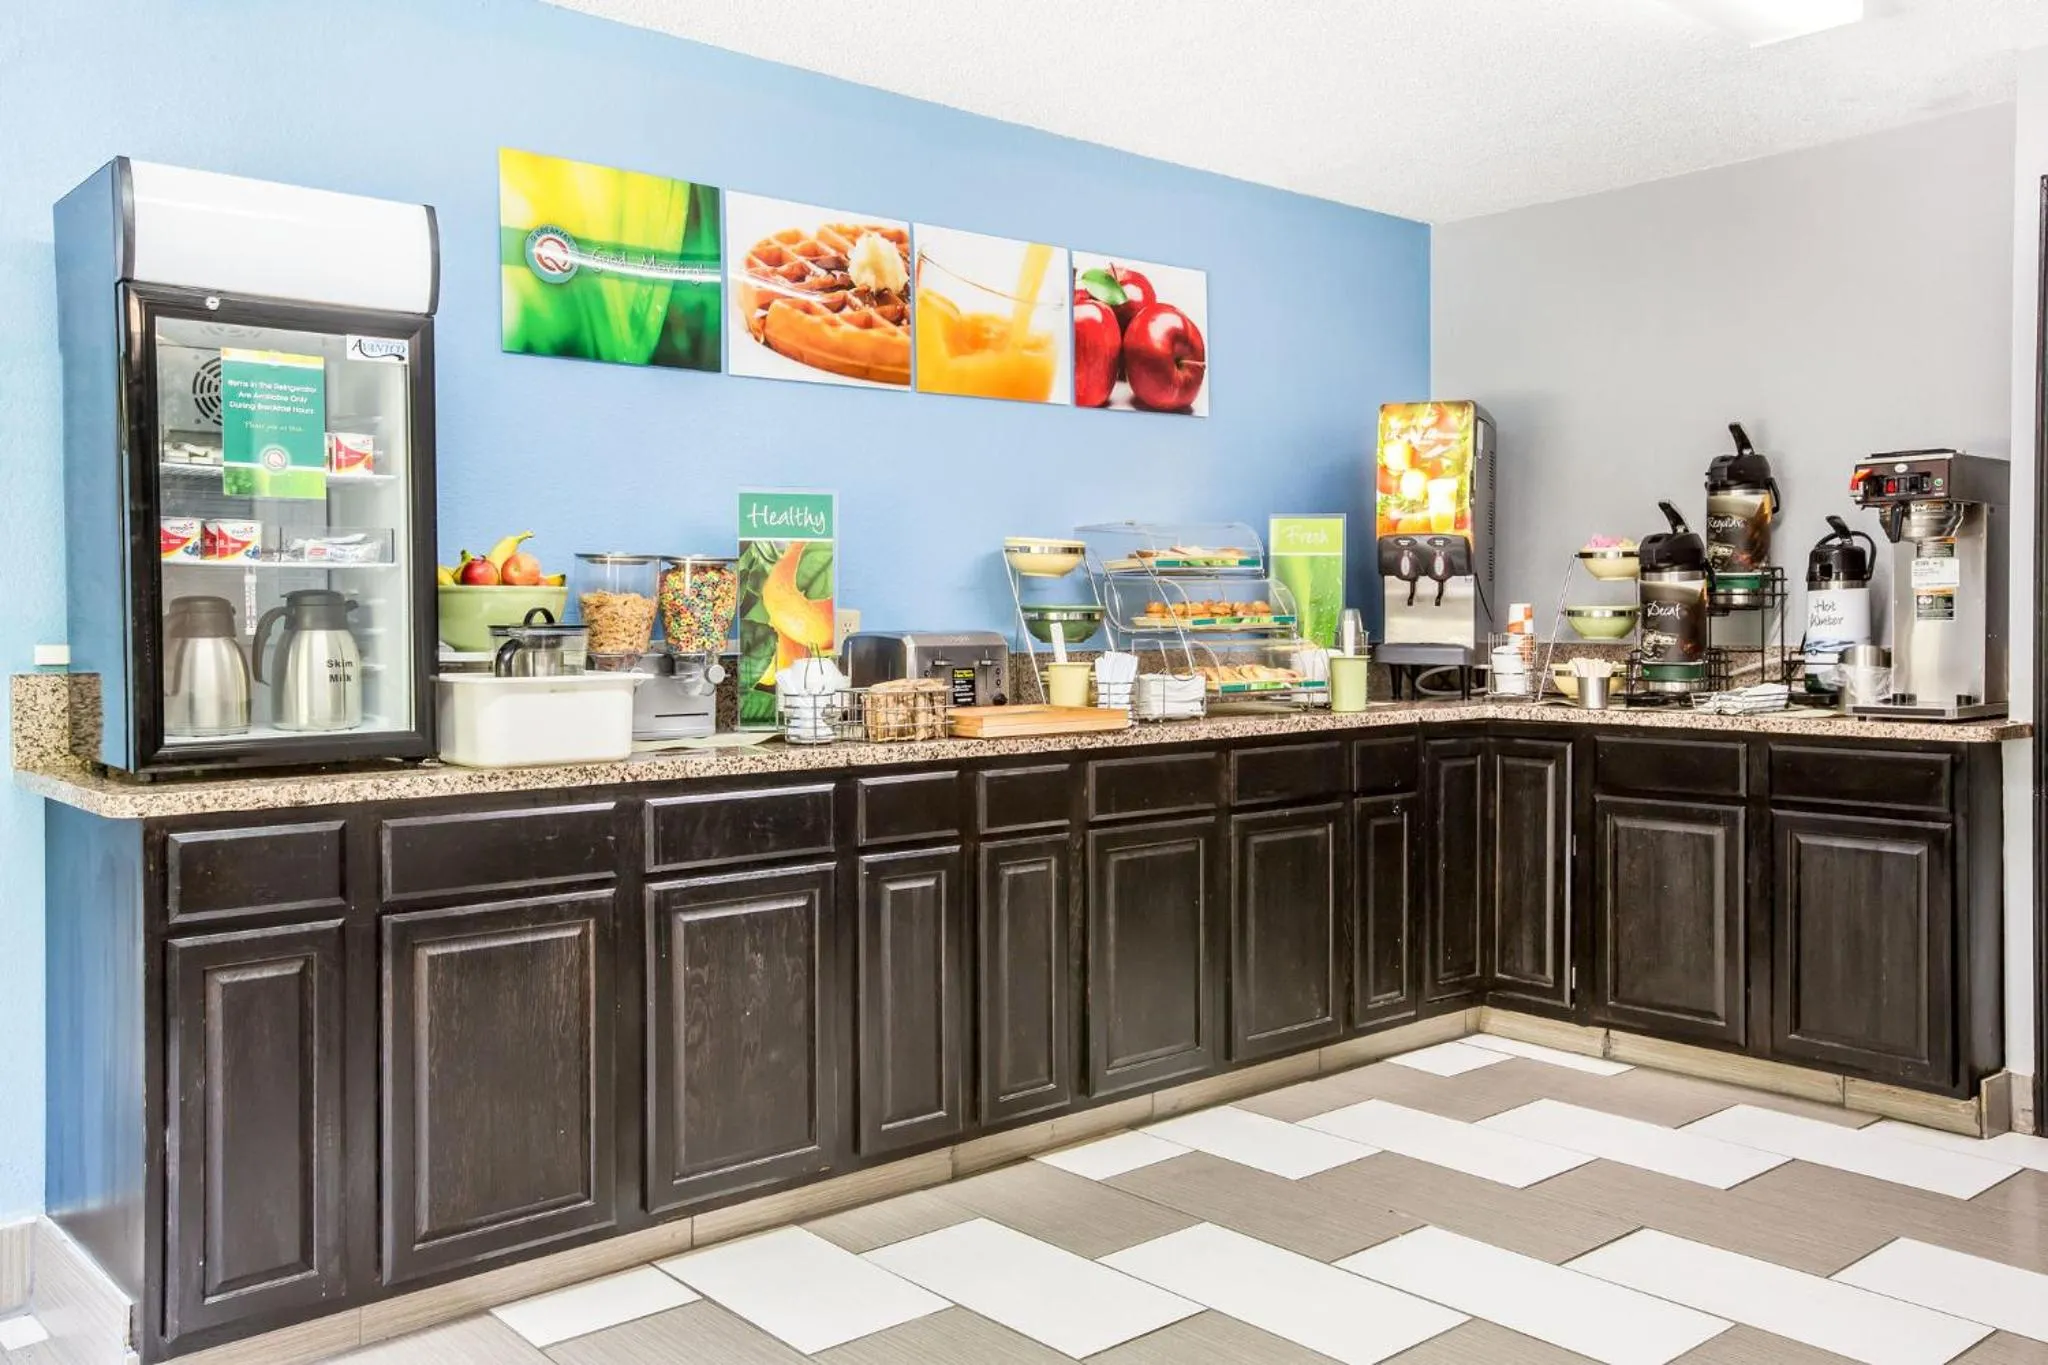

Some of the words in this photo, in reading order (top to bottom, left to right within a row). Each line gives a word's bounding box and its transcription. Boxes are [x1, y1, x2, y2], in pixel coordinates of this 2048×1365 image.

[592, 247, 627, 274] Good
[229, 401, 256, 411] During
[746, 502, 826, 535] Healthy
[1280, 524, 1330, 545] Fresh
[1647, 600, 1681, 621] Decaf
[1813, 599, 1837, 612] Hot
[327, 658, 353, 669] Skim
[329, 673, 352, 682] Milk
